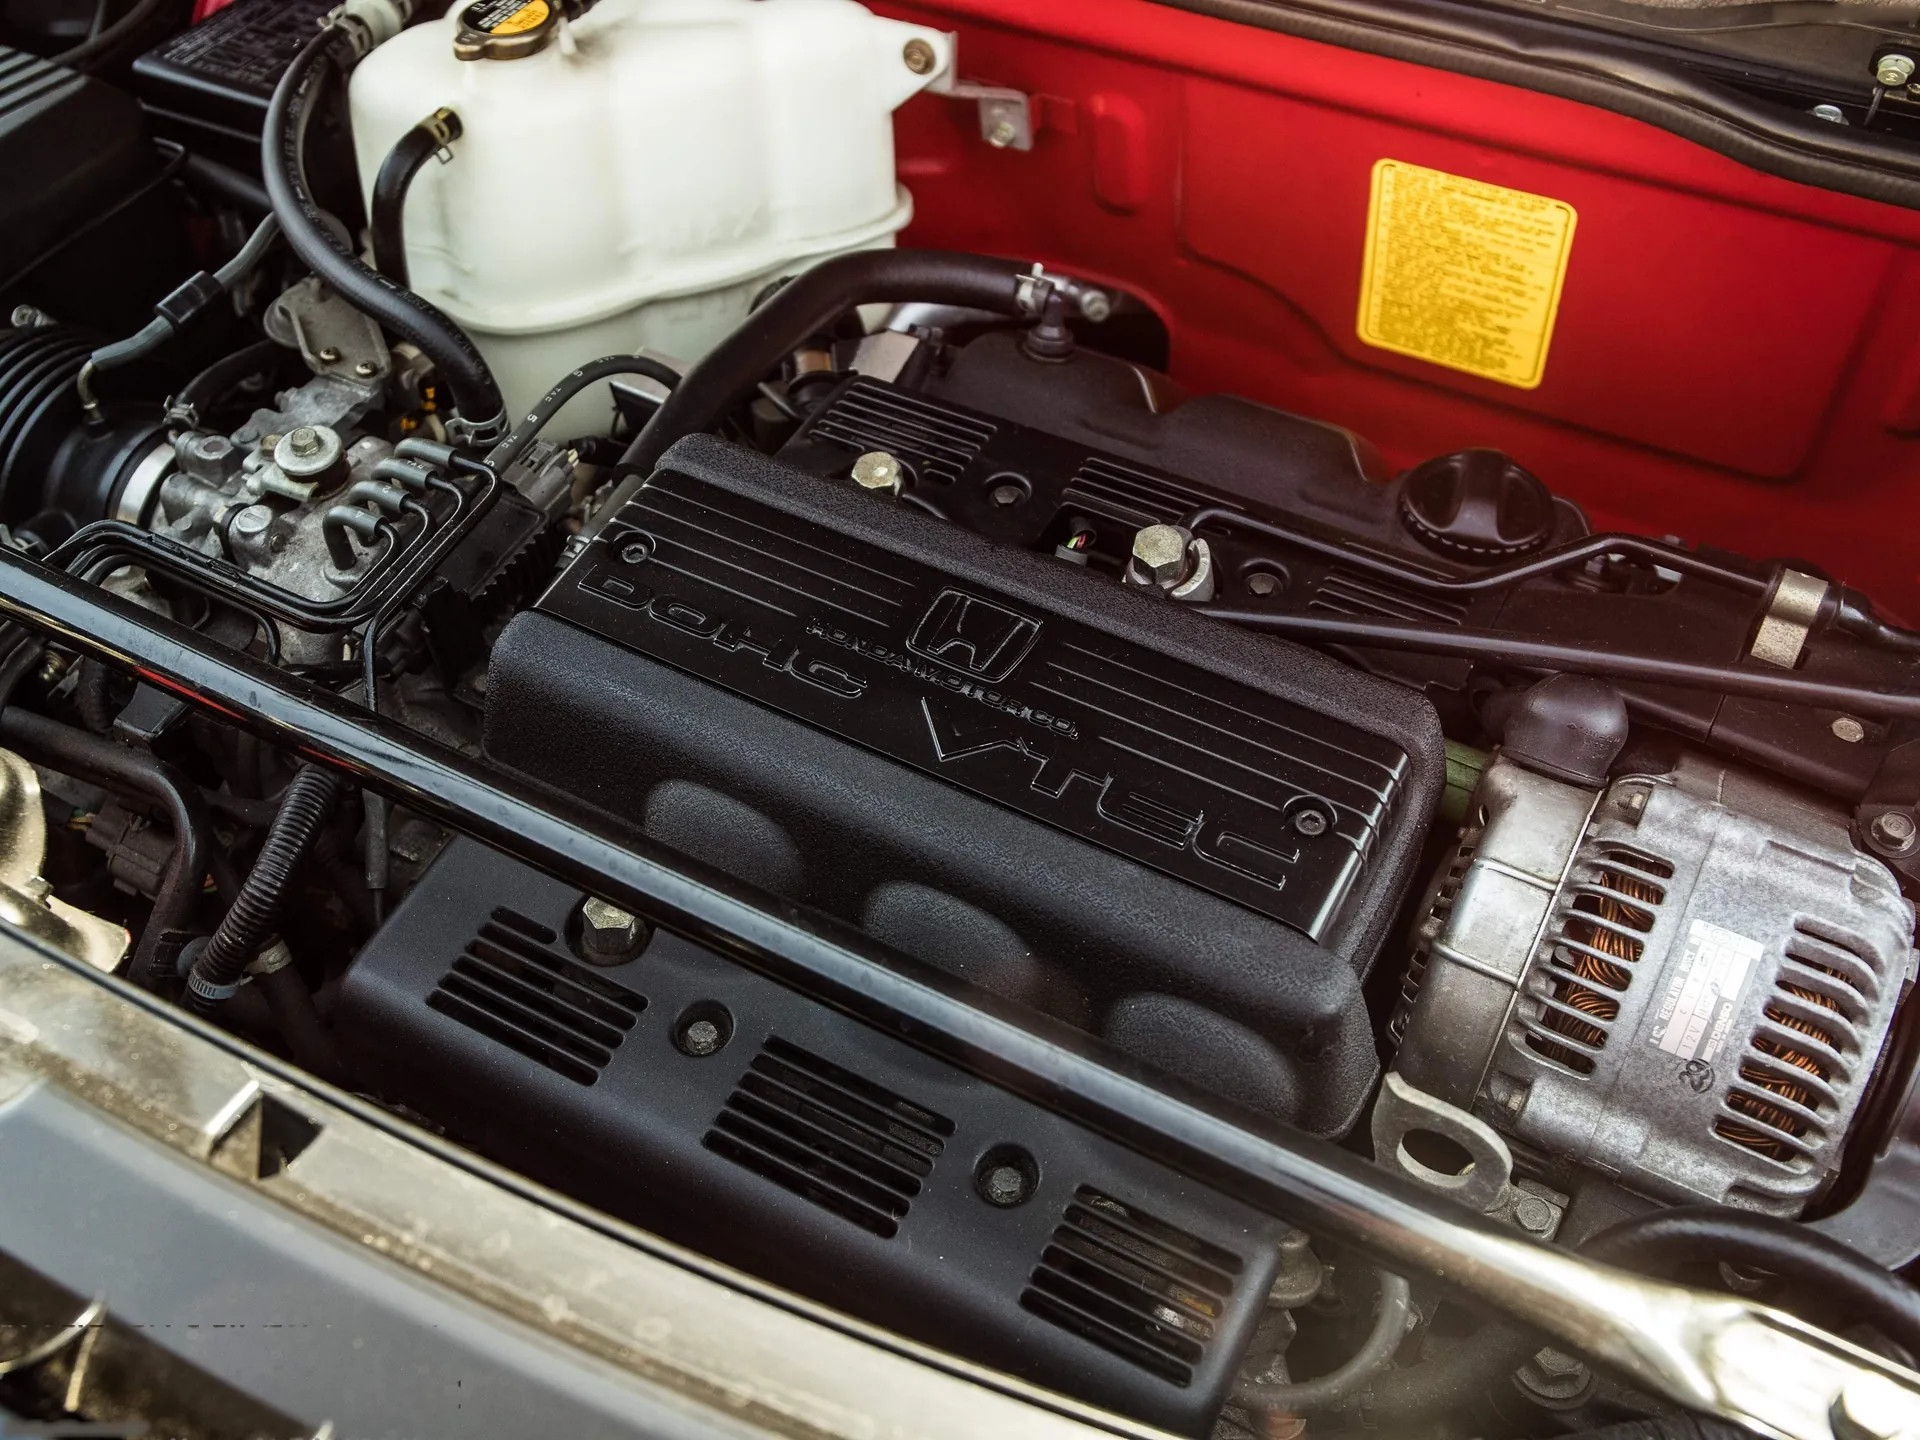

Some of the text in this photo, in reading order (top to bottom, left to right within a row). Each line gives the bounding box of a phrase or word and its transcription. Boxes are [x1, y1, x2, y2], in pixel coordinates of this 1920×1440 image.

[527, 413, 538, 423] 5
[577, 563, 868, 699] DOHC
[806, 615, 911, 672] HONDA
[913, 663, 1024, 718] MOTOR
[921, 696, 1301, 890] VTEC
[1659, 976, 1686, 1020] REGULATOR
[1682, 1024, 1701, 1050] 12V
[1711, 1001, 1734, 1040] DENSO
